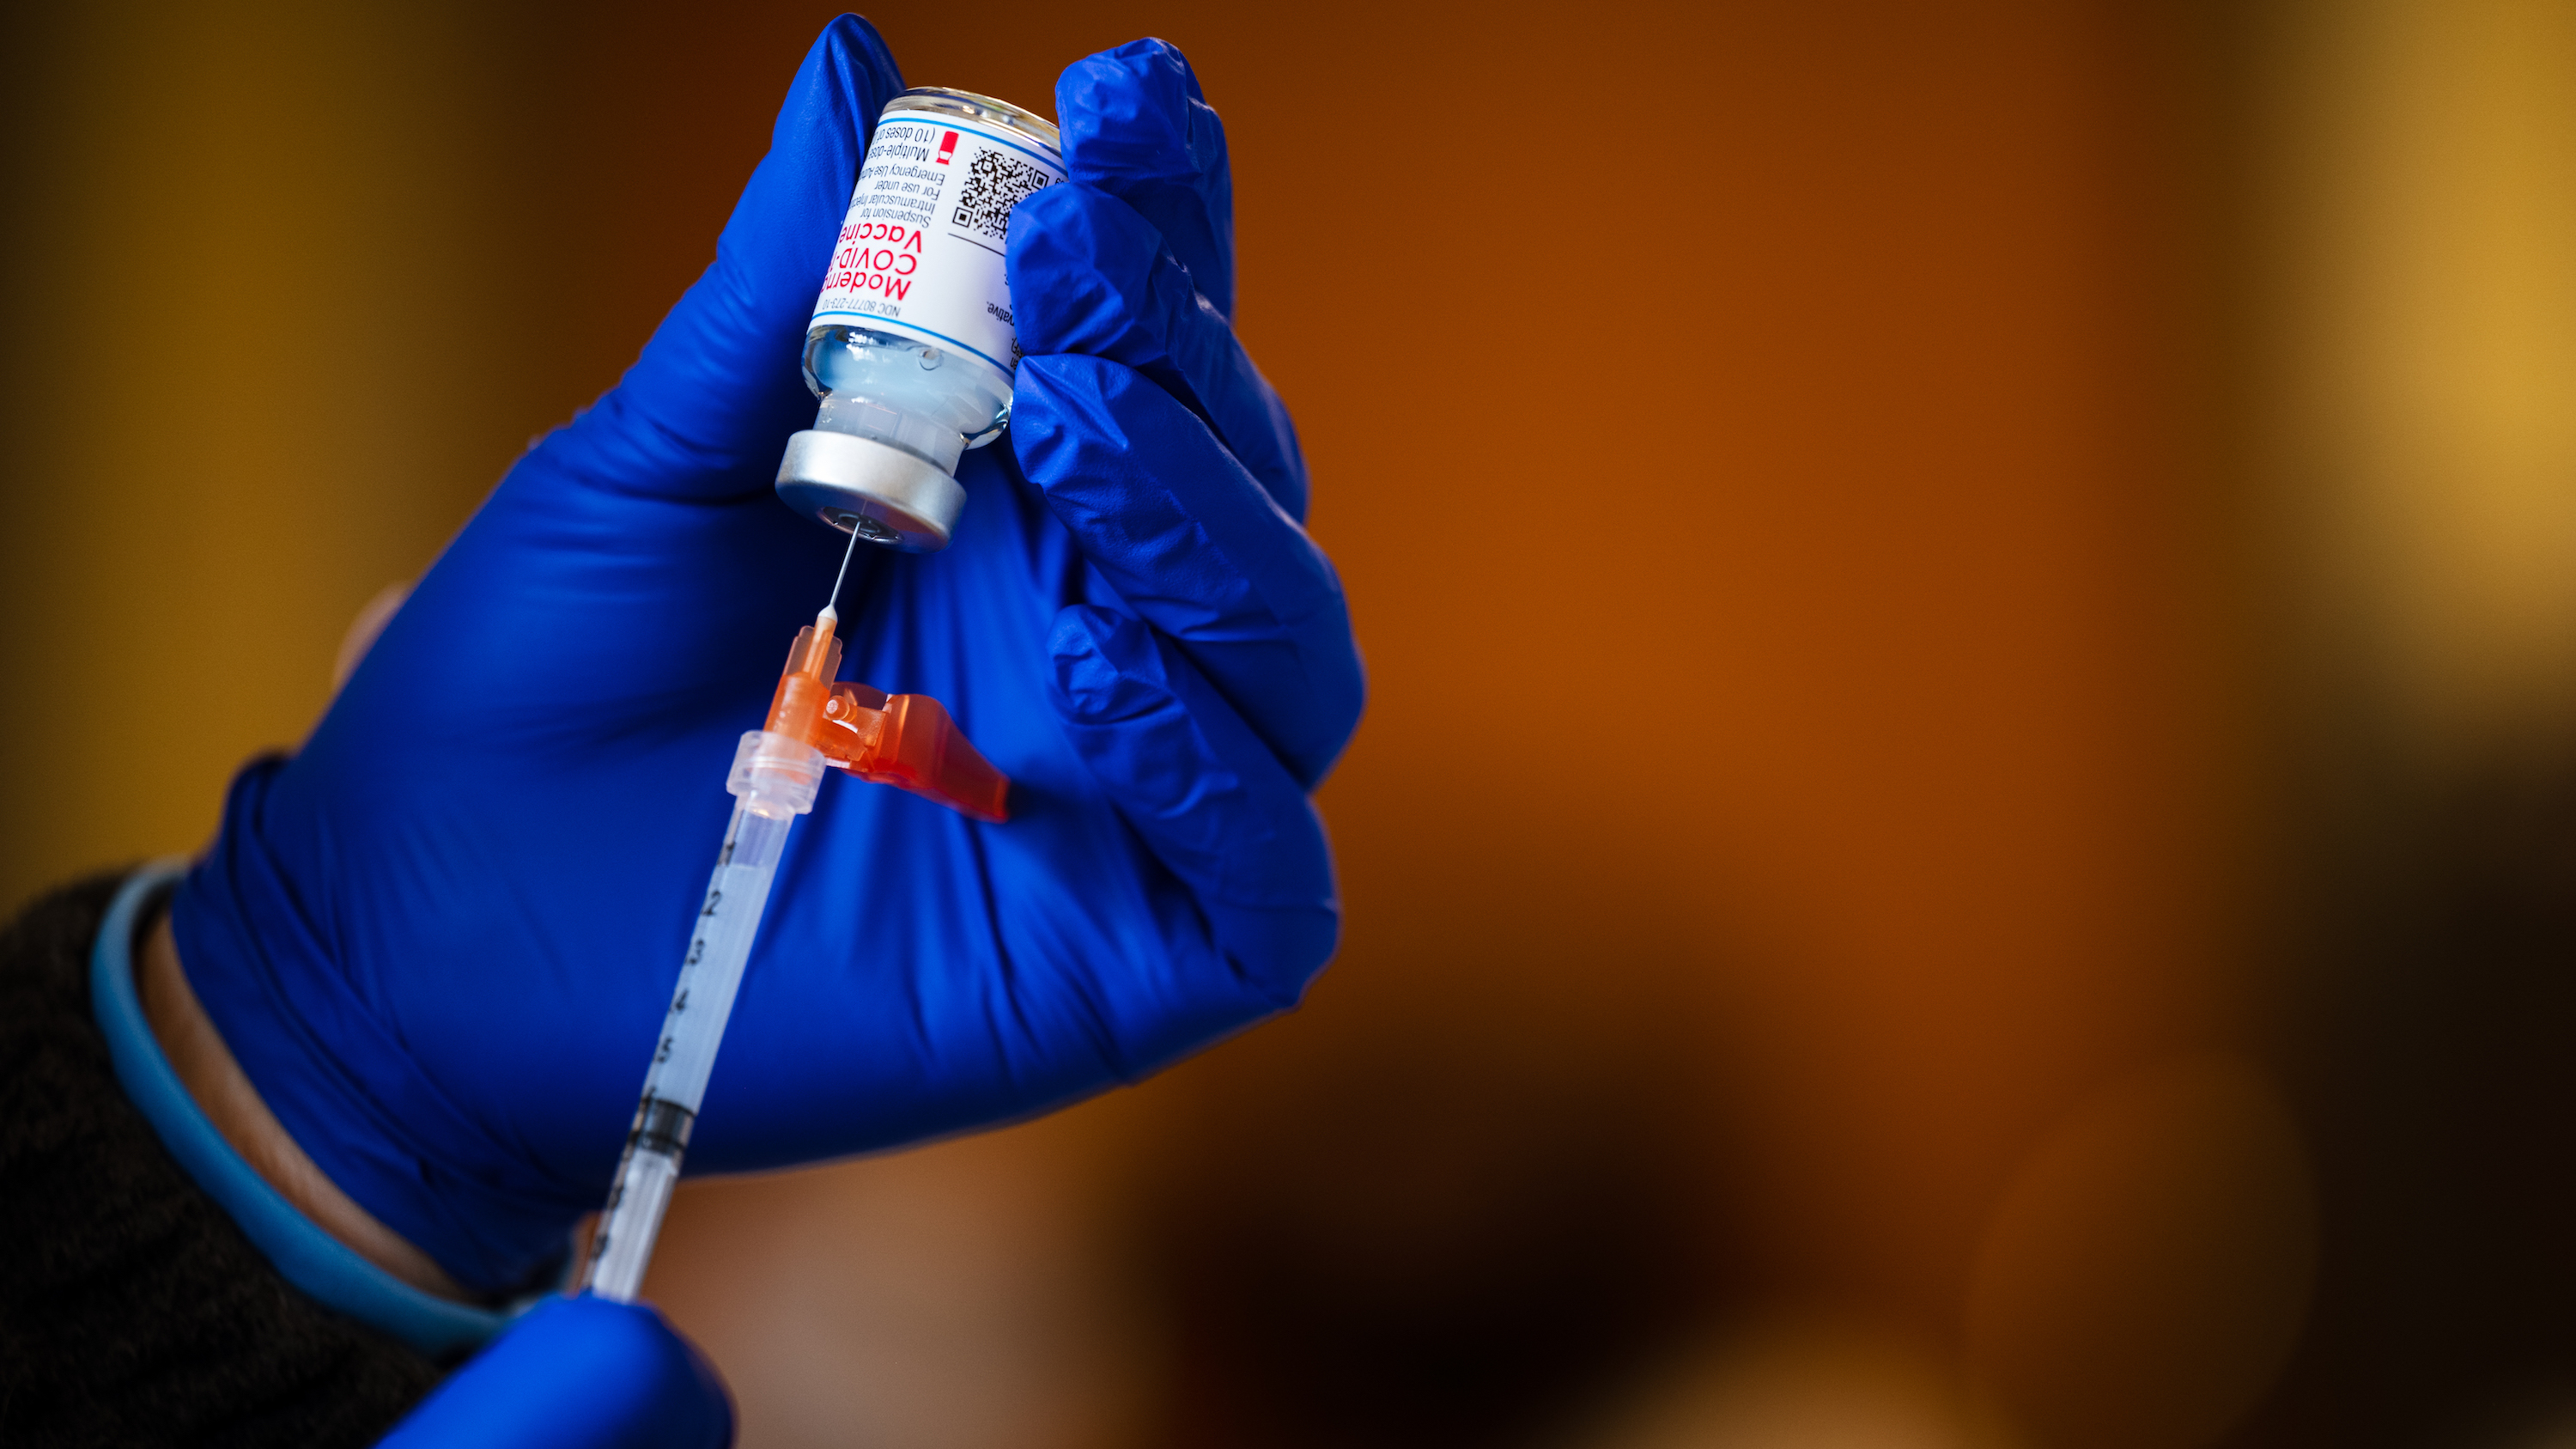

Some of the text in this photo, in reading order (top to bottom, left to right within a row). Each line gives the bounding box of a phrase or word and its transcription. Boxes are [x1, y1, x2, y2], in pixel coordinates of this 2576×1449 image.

[884, 126, 914, 141] doses
[914, 126, 936, 144] (10
[873, 165, 889, 178] Use
[889, 163, 946, 186] Emergency
[873, 180, 941, 201] For use under
[868, 194, 936, 216] Intramuscular
[860, 207, 932, 228] Suspension for
[839, 222, 922, 253] Vaccine
[822, 297, 901, 318] NDC 80777-273-10
